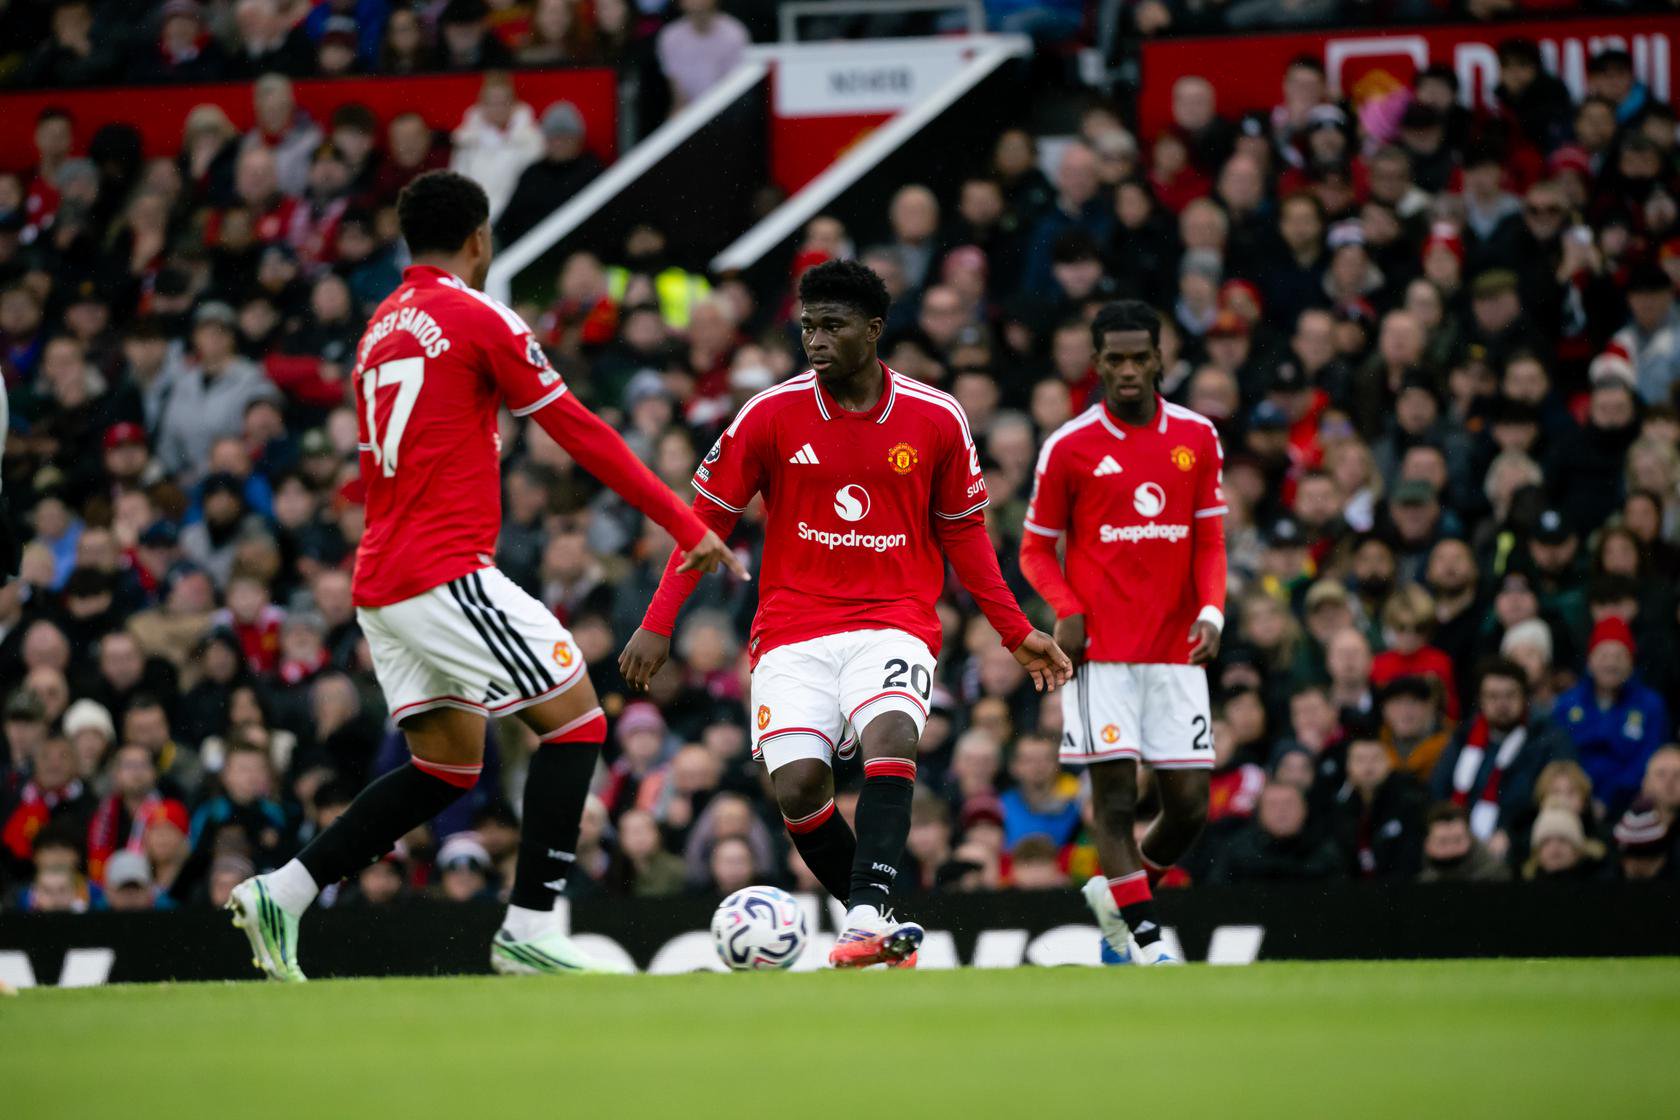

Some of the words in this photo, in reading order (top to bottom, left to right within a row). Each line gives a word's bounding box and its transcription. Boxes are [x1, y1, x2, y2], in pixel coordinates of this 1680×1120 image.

[396, 306, 451, 359] SANTOS
[362, 356, 425, 478] 17
[798, 521, 906, 552] Snapdragon
[882, 658, 931, 701] 20
[1191, 714, 1212, 751] 2
